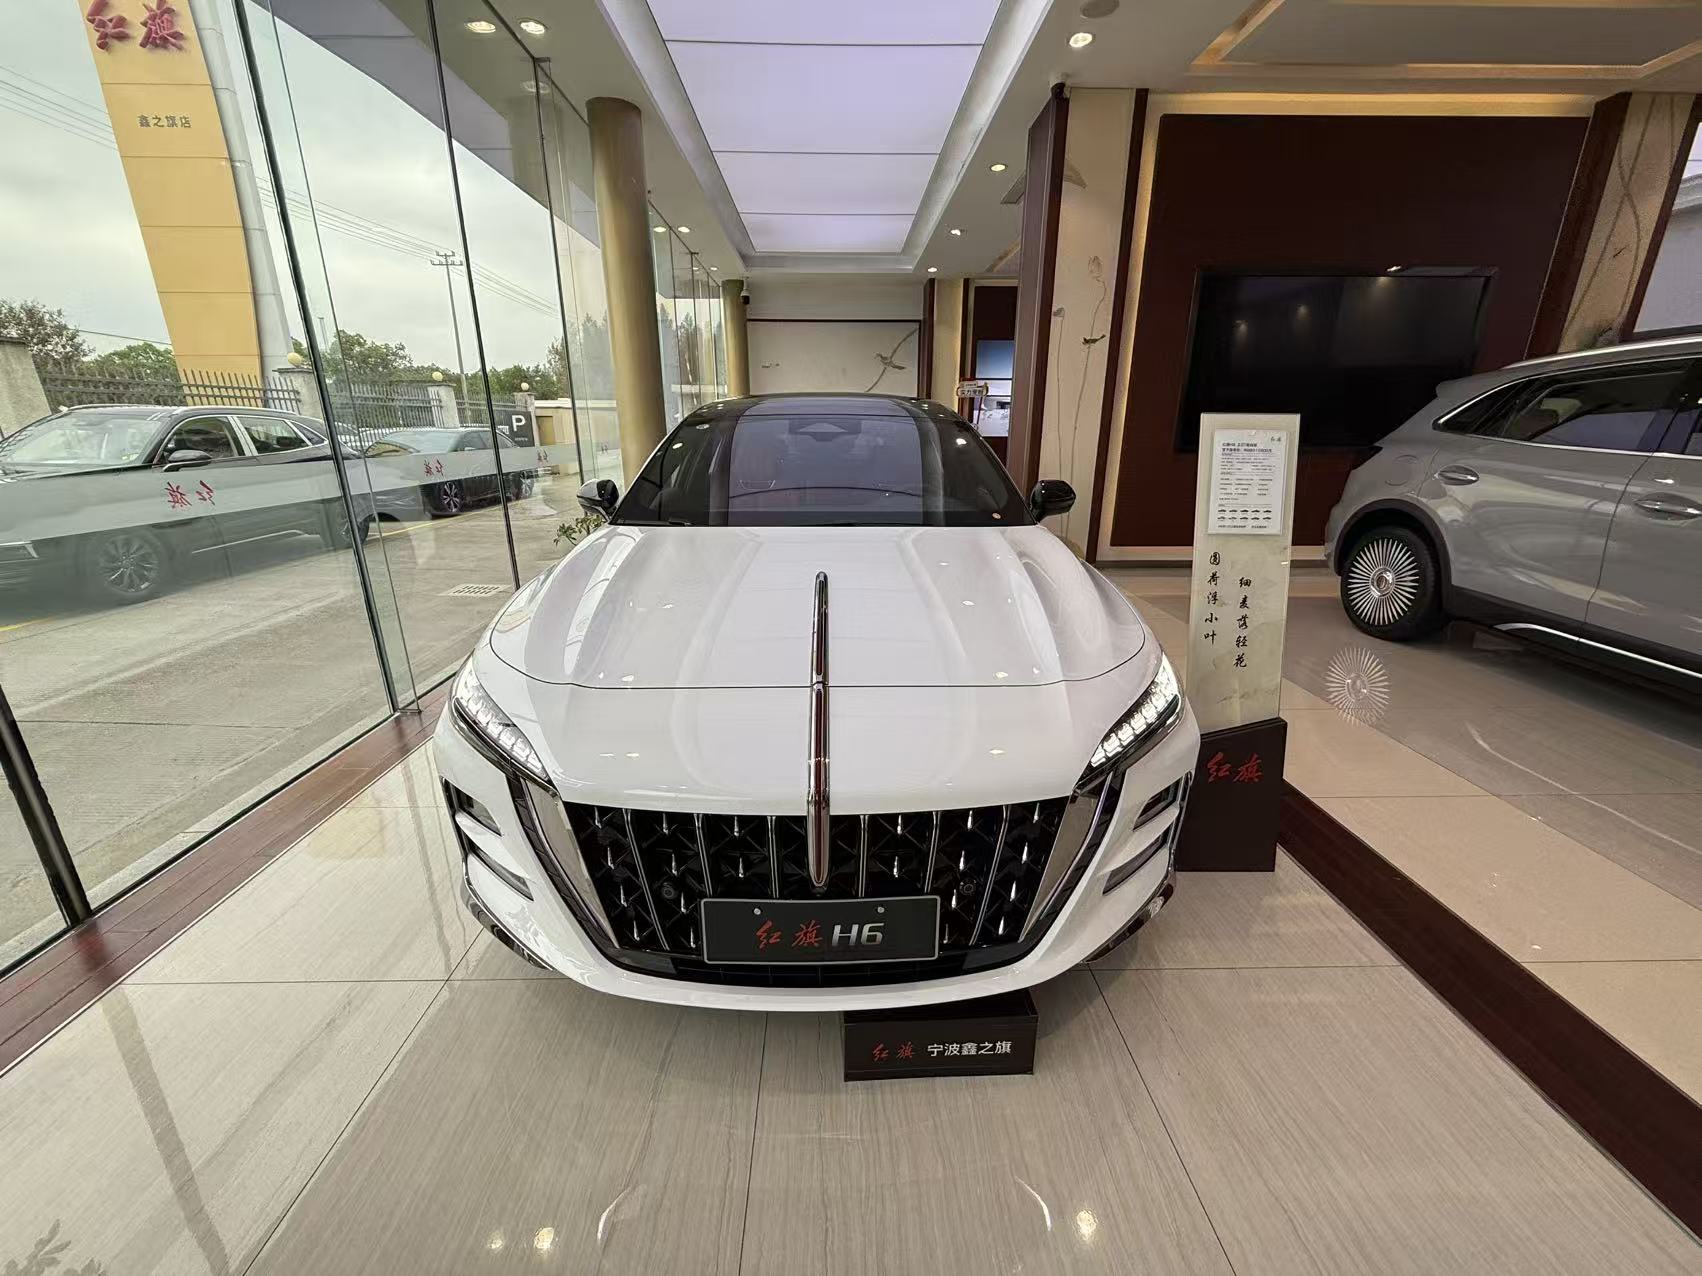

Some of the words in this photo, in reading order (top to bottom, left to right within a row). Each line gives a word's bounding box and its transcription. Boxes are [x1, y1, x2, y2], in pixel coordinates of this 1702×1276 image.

[138, 115, 191, 128] 鑫之旗店
[511, 414, 526, 432] P
[1203, 551, 1220, 645] 圆荷浮小叶
[1233, 577, 1251, 668] 细麦落轻花
[1207, 752, 1262, 783] 红旗
[756, 920, 822, 948] 红旗
[832, 923, 884, 946] H6
[872, 1042, 914, 1061] 红旗
[927, 1041, 1012, 1057] 宁波鑫之旗
